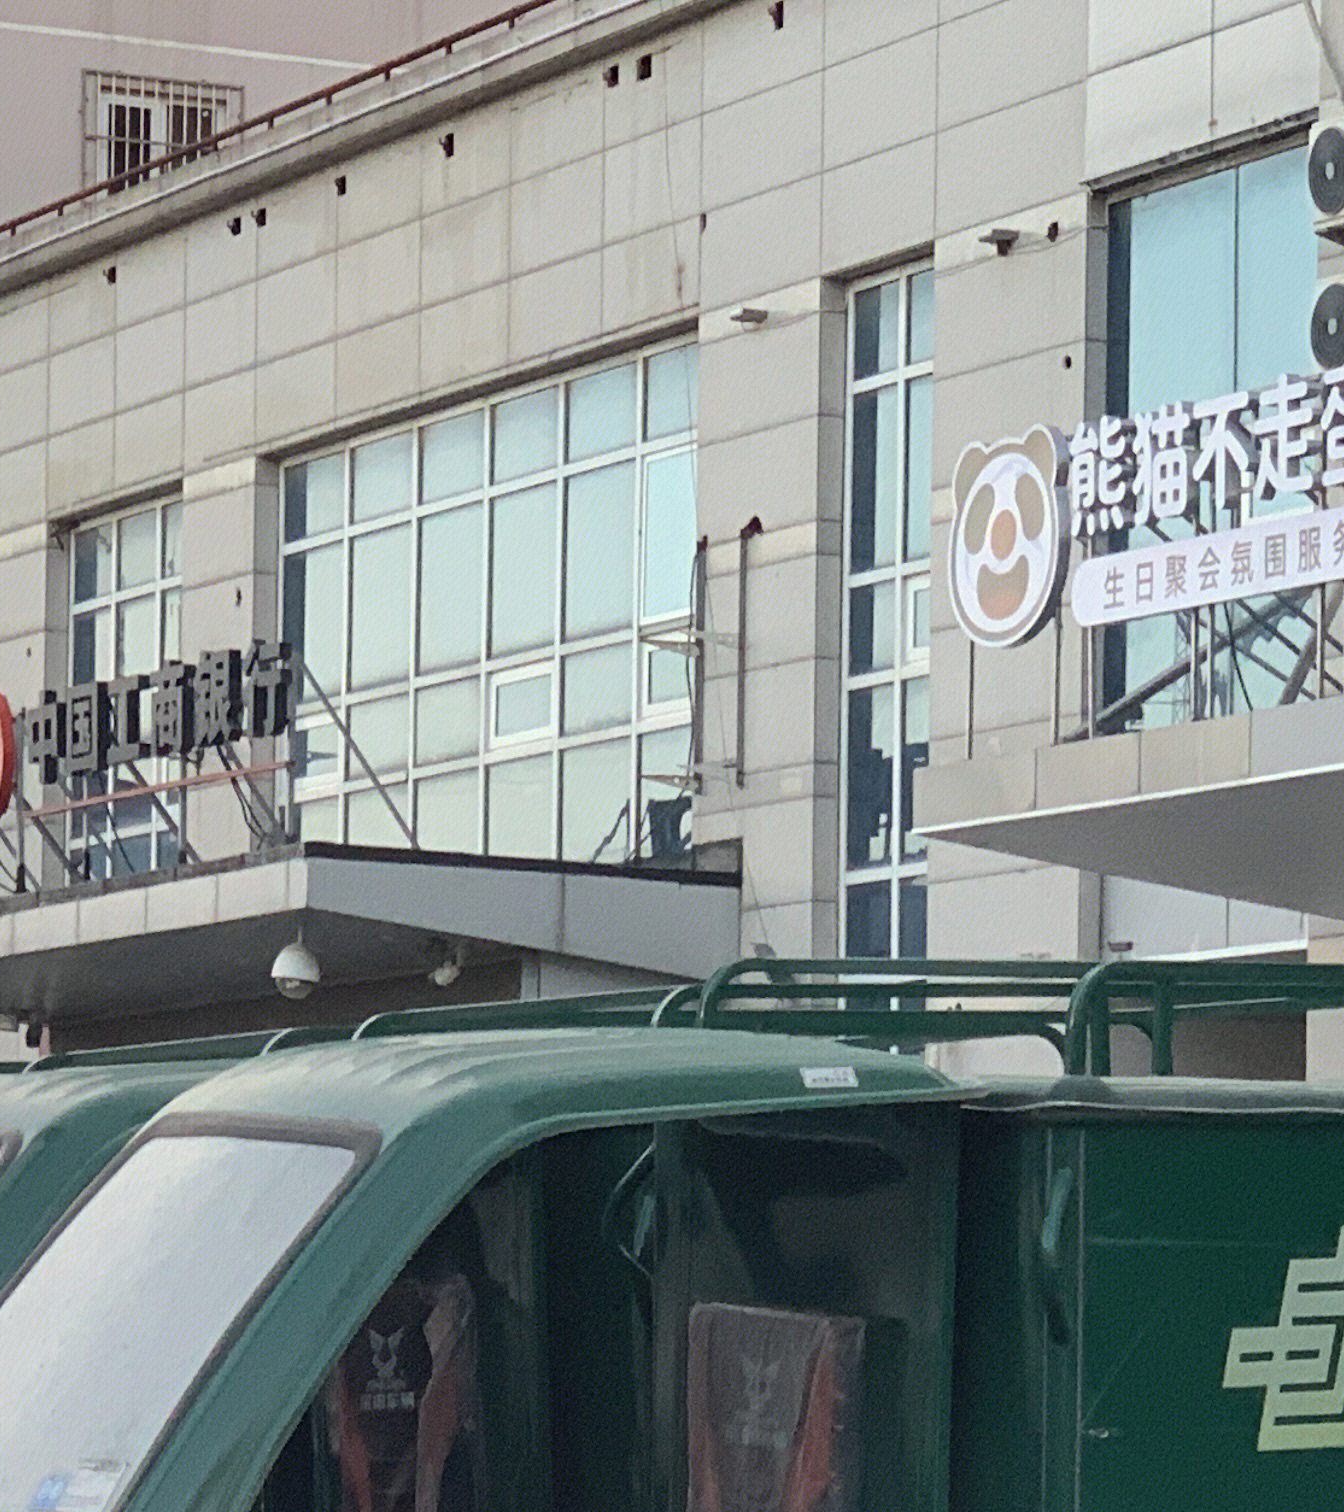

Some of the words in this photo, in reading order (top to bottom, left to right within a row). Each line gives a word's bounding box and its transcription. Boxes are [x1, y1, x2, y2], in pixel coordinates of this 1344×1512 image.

[26, 640, 293, 785] 中国工商银行
